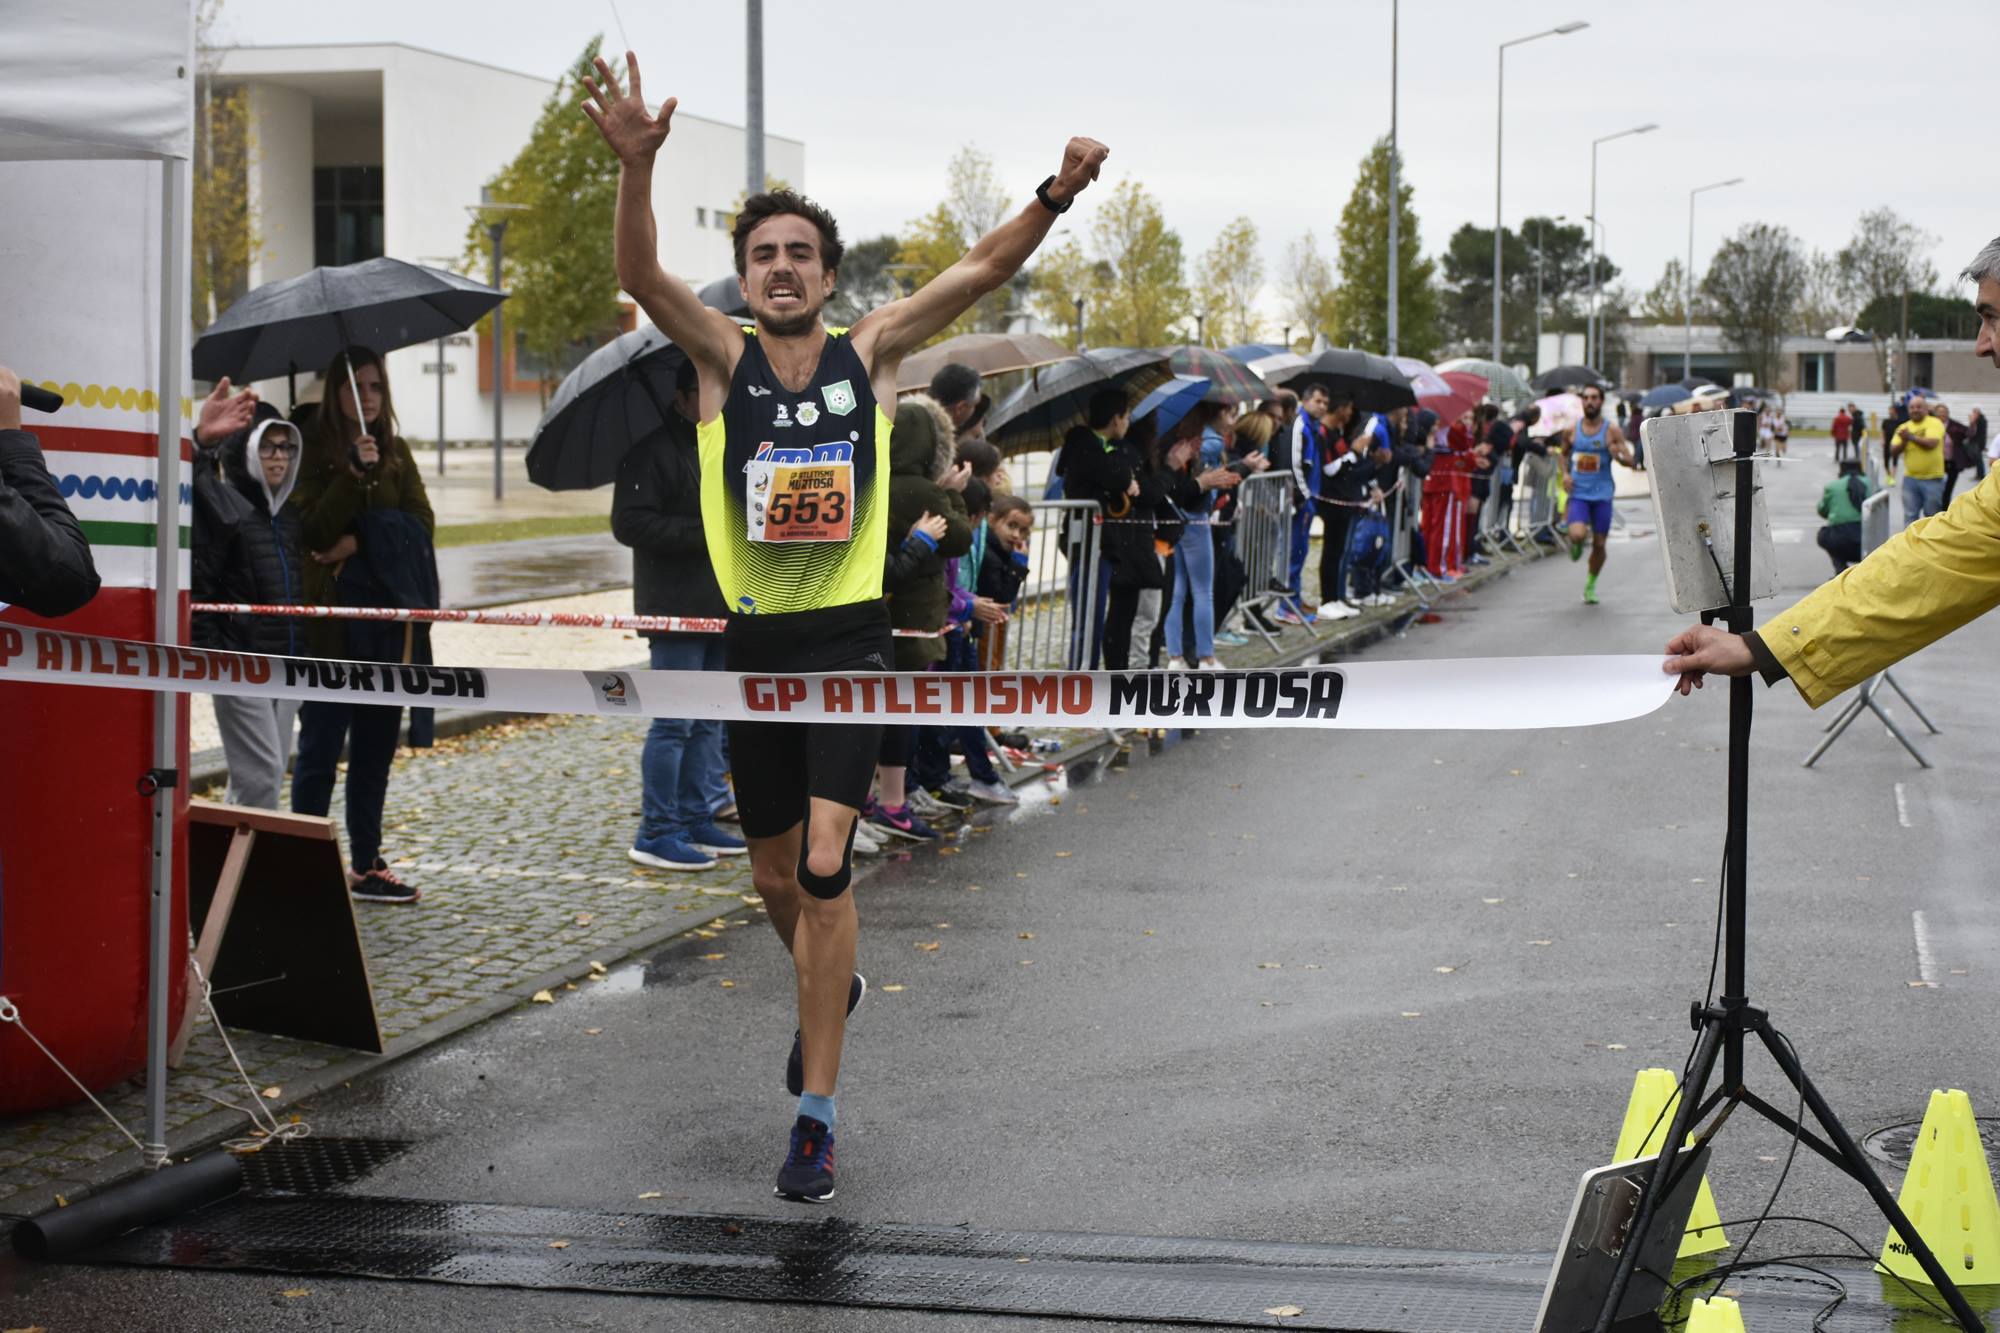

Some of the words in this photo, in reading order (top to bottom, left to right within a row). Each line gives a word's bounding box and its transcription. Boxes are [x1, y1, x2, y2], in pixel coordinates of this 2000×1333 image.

[787, 478, 834, 491] MURTOSA
[769, 491, 845, 525] 553
[0, 627, 23, 667] P
[35, 631, 271, 684] ATLETISMO
[284, 657, 486, 698] MURTOSA
[744, 677, 807, 711] GP
[822, 675, 1092, 715] ATLETISMO
[1109, 671, 1344, 719] MURTOSA
